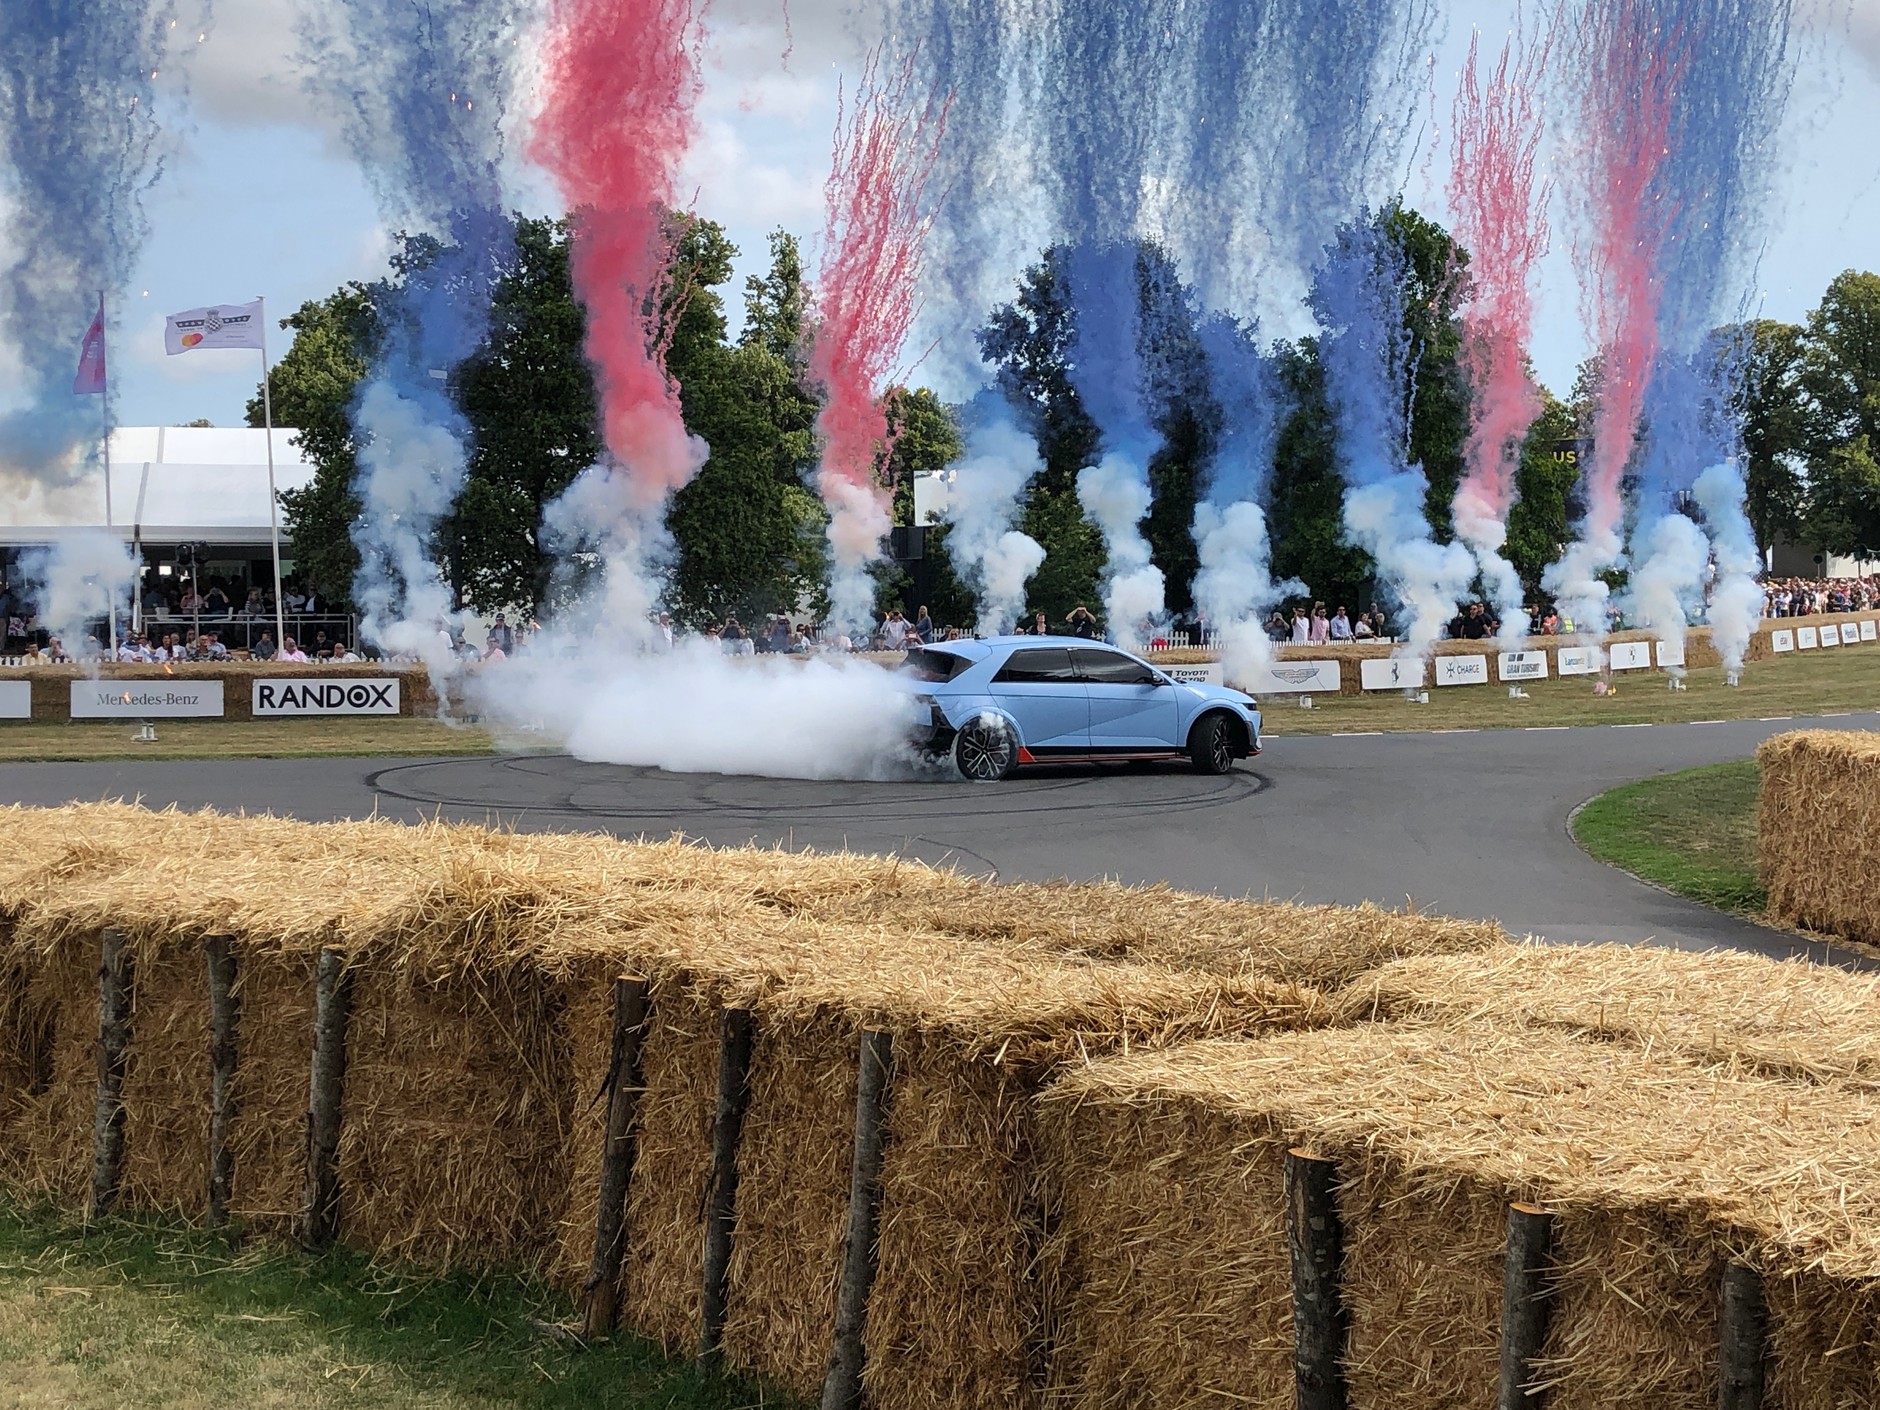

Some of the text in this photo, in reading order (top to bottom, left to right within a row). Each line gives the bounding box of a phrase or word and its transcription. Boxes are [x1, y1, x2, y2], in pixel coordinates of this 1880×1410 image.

[1457, 664, 1479, 674] CHARGE
[97, 692, 199, 706] Mercedes-Benz
[259, 684, 393, 709] RANDOX
